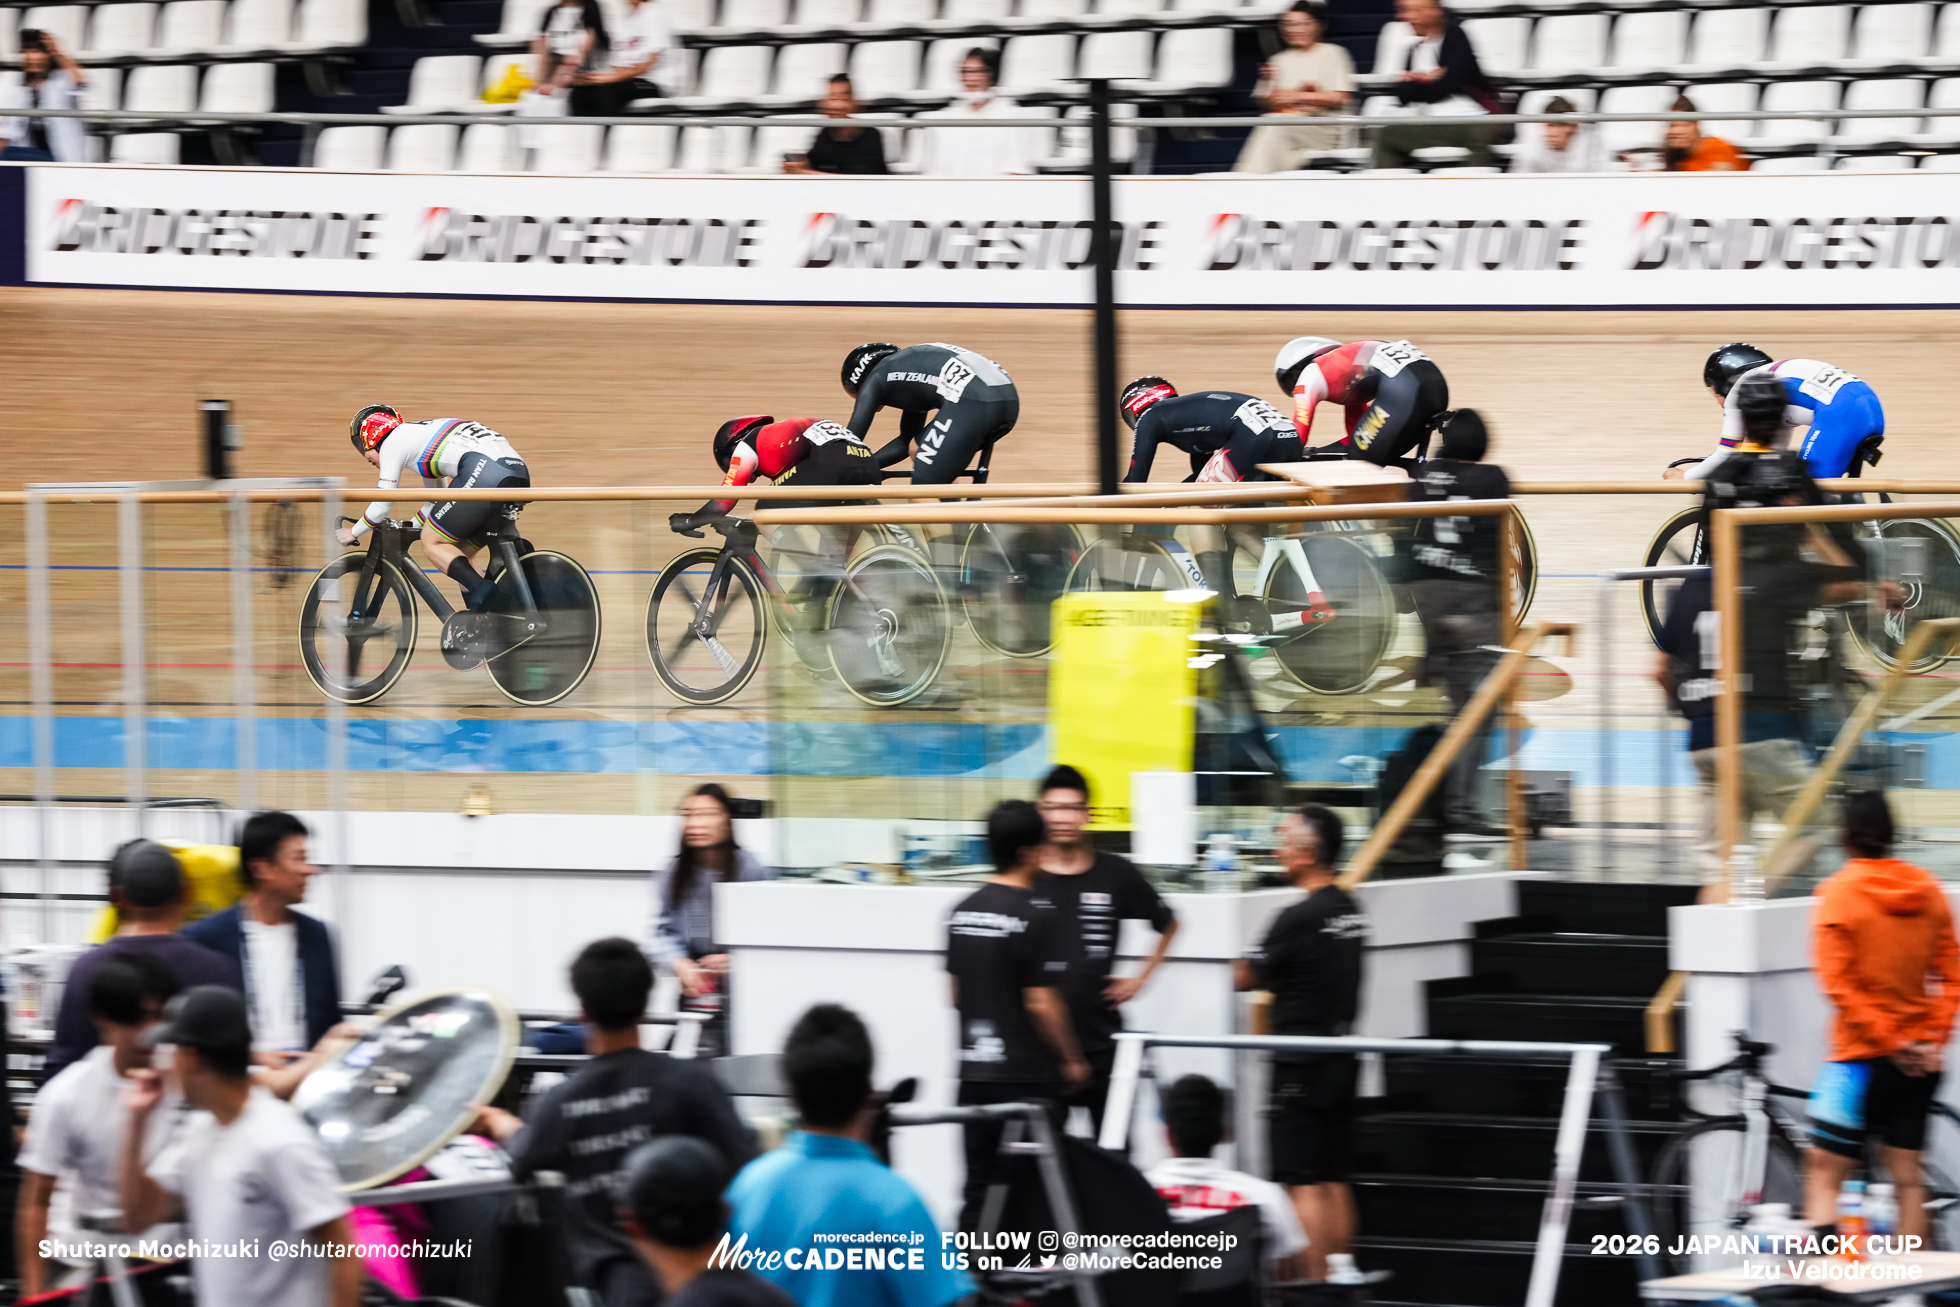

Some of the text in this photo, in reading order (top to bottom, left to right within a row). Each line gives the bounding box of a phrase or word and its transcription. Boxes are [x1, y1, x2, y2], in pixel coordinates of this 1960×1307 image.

[54, 198, 382, 261] BRIDGESTONE
[416, 206, 763, 268] BRIDGESTONE
[1204, 212, 1586, 272] BRIDGESTONE
[1632, 211, 1960, 271] BRIDGESTO
[472, 458, 488, 478] TEAM
[916, 418, 953, 465] NZL
